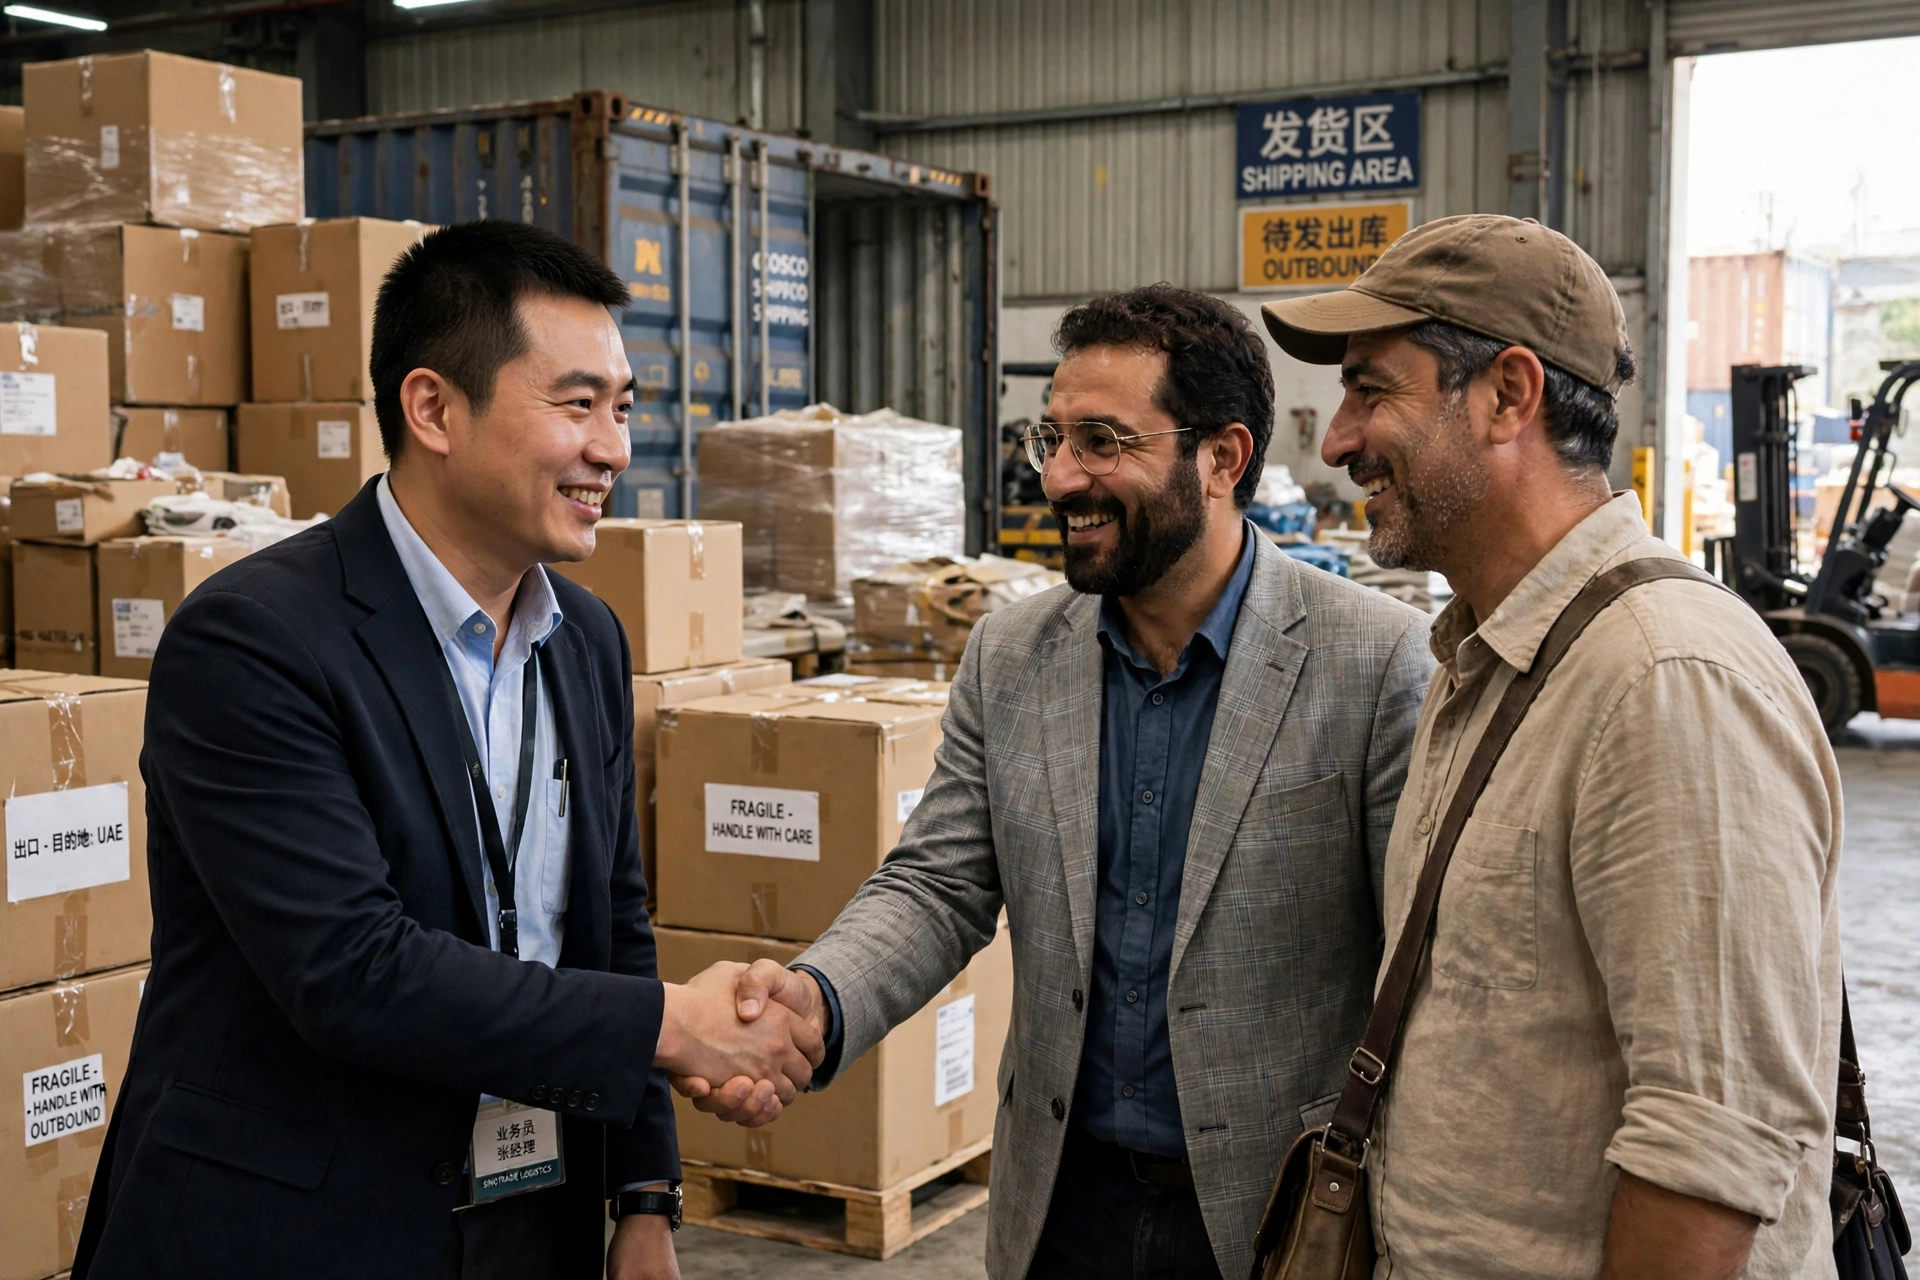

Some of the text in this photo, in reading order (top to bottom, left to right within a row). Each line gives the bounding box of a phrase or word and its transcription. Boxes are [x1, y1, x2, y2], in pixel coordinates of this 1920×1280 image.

[1259, 103, 1394, 161] 发货区
[1242, 155, 1414, 193] SHIPPING AREA
[1261, 213, 1388, 254] 待发出库
[731, 799, 785, 820] FRAGILE
[14, 838, 39, 859] 出口
[97, 823, 123, 844] UAE
[712, 821, 813, 845] HANDLE WITH CARE
[32, 1063, 91, 1095] FRAGILE
[33, 1090, 78, 1117] HANDLE
[30, 1106, 101, 1140] OUTBOUND
[496, 1119, 536, 1142] 业务员
